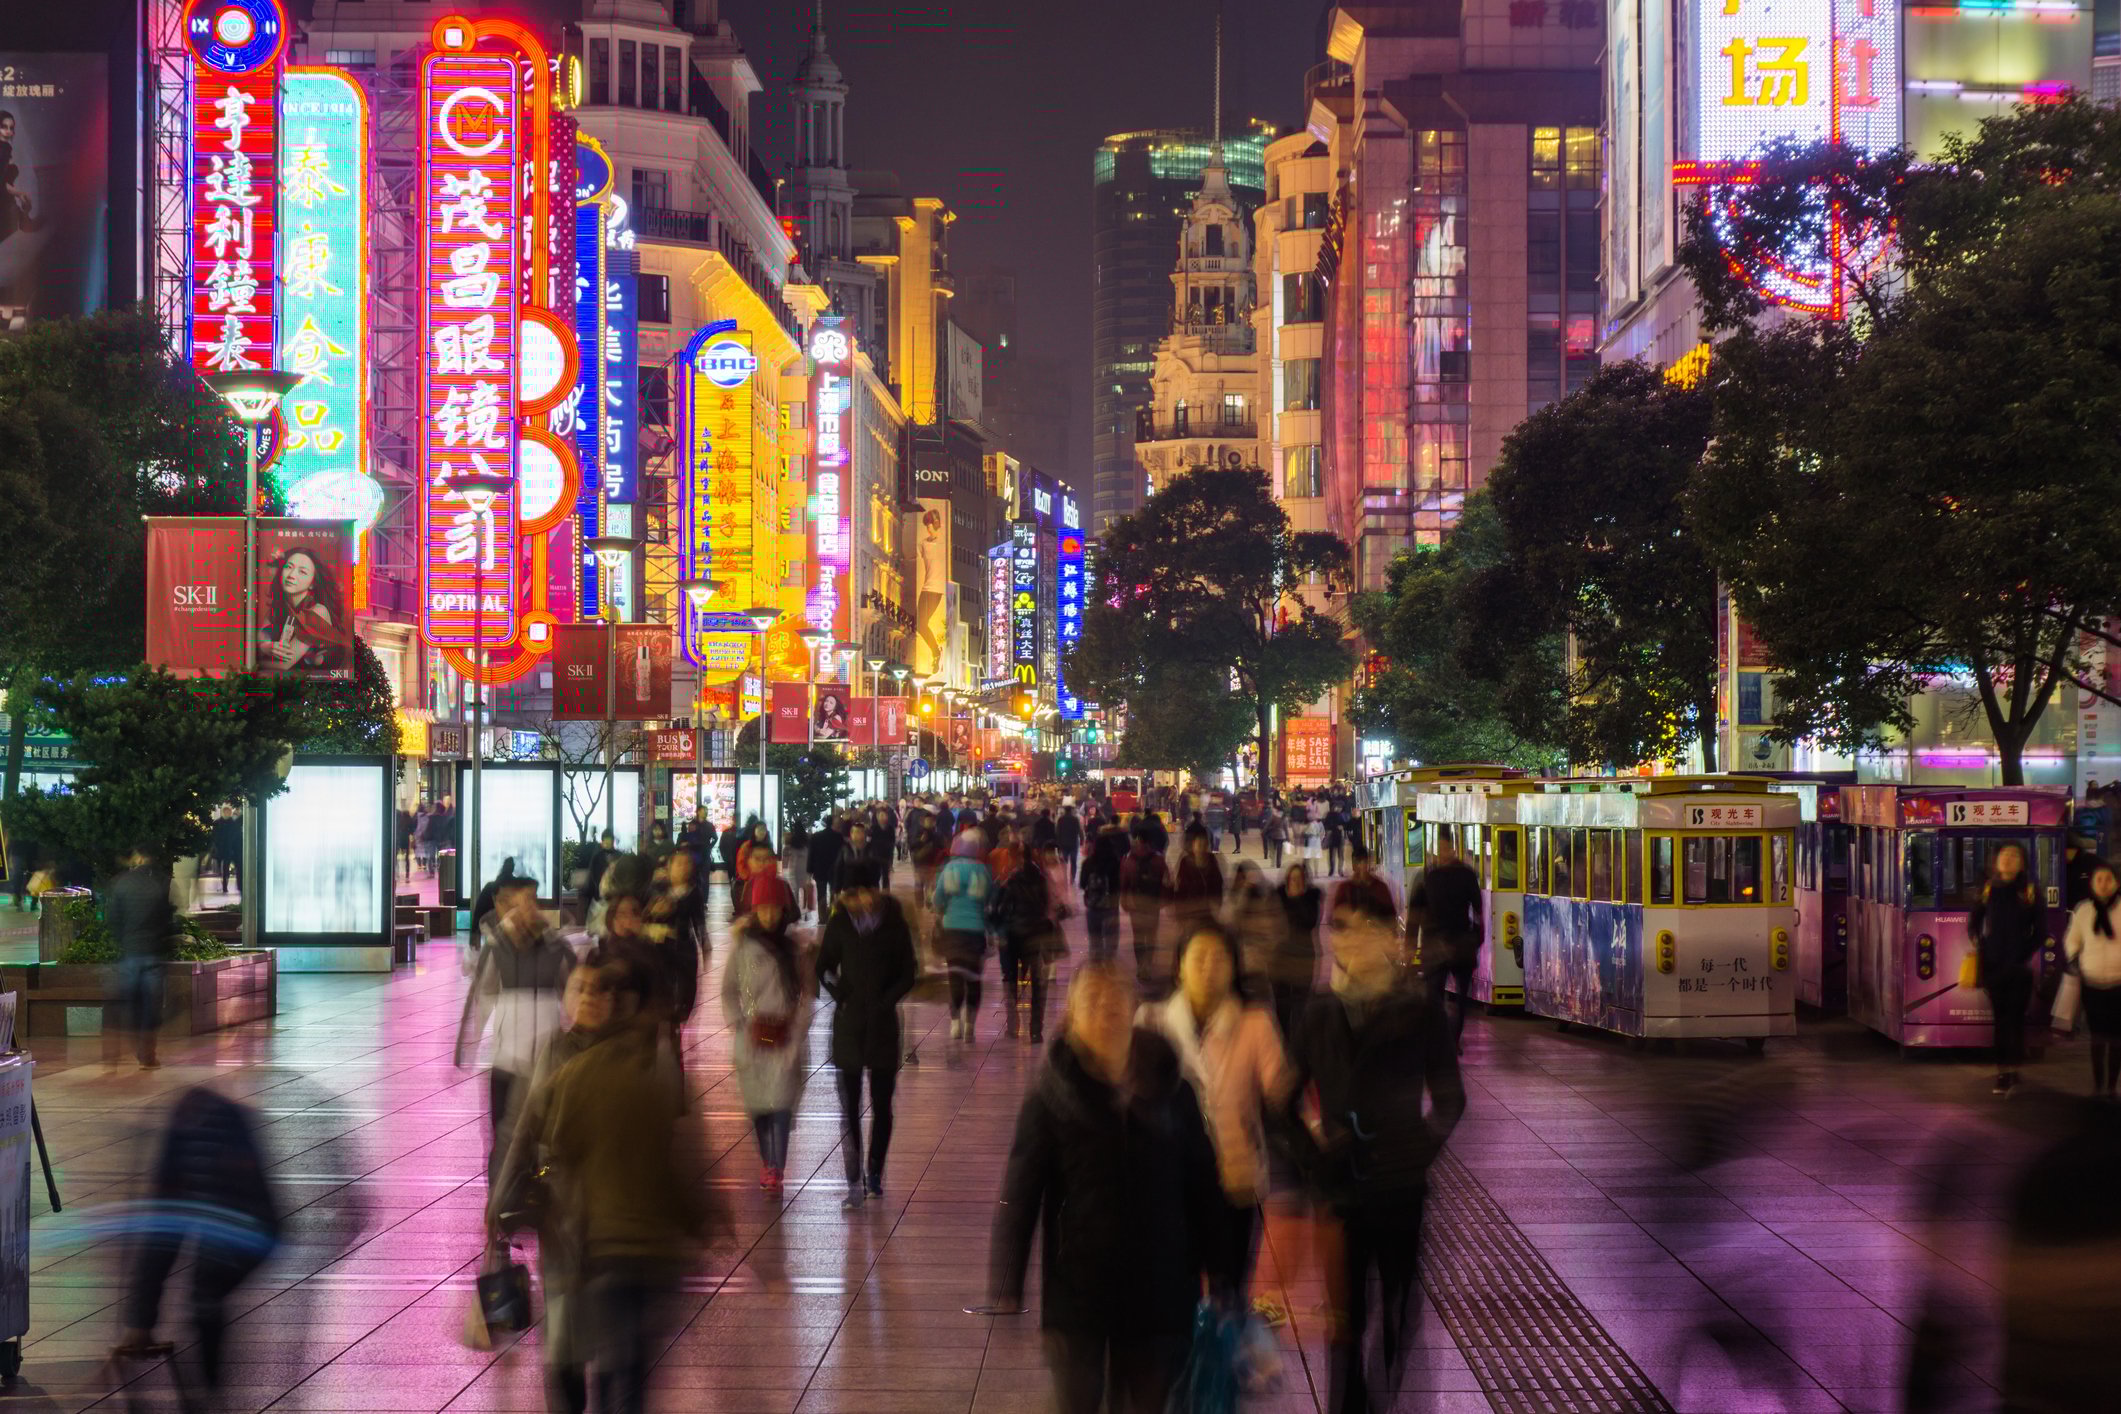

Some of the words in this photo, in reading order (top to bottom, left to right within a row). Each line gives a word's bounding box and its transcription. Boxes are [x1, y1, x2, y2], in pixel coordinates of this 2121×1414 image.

[224, 53, 236, 66] V
[282, 130, 352, 454] 泰康食品
[701, 358, 756, 370] BAC
[173, 585, 217, 605] SK-II
[432, 594, 505, 611] OPTIAL
[1020, 618, 1034, 659] 真丝大王
[656, 735, 679, 743] BUS
[1287, 738, 1307, 752] 年终
[1287, 754, 1307, 768] 特卖
[1711, 808, 1754, 819] 观光车
[1973, 804, 2020, 816] 观光车
[1905, 817, 1934, 825] HUAWEI
[1780, 886, 1788, 901] 2
[2047, 889, 2059, 905] 10
[1700, 958, 1748, 973] 每一代
[1678, 976, 1774, 992] 都是一个时代
